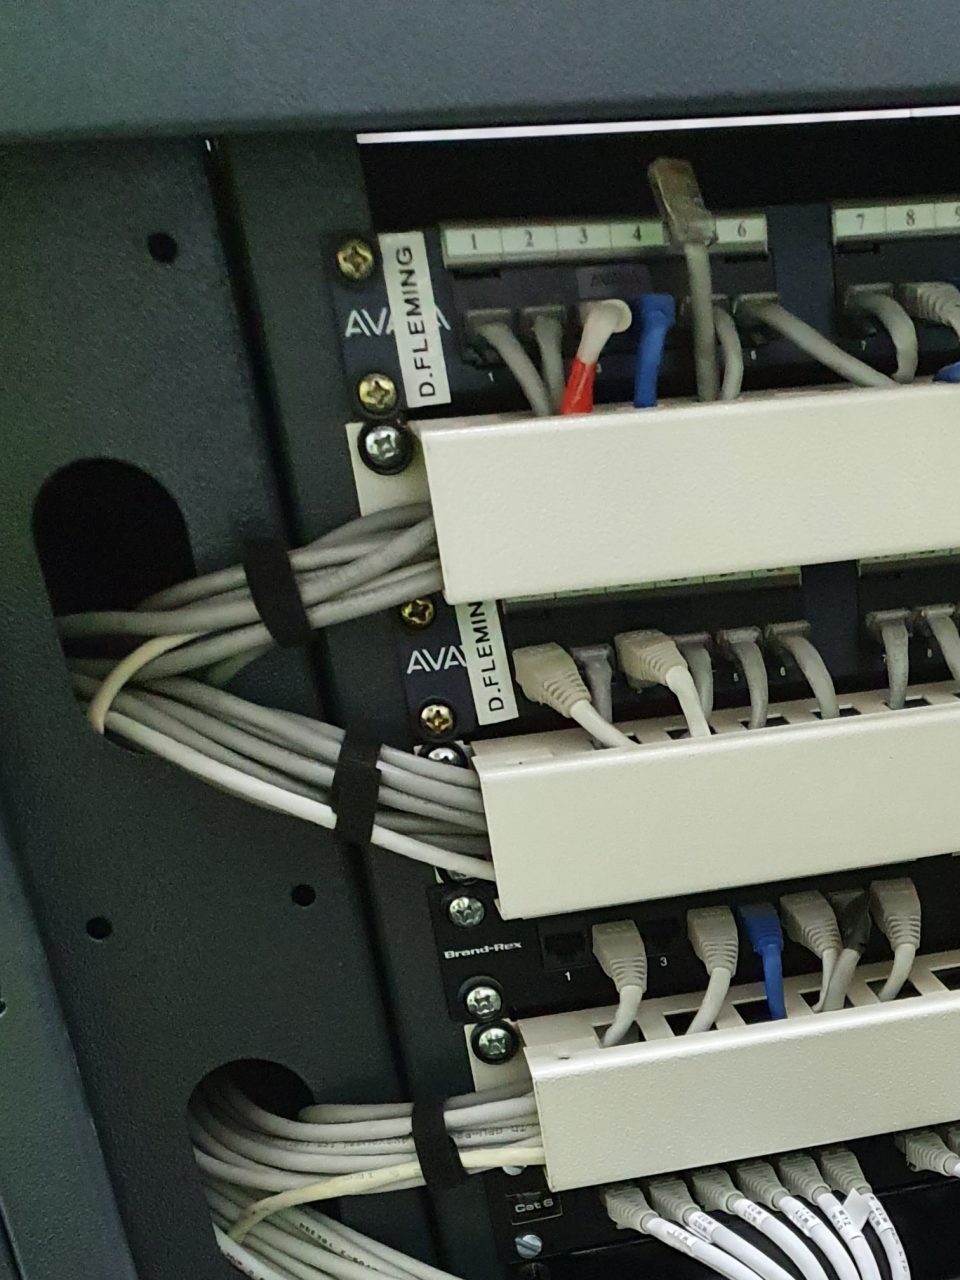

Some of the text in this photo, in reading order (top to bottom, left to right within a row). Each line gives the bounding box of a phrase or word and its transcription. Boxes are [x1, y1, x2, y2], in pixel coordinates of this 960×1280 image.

[856, 214, 865, 230] 7
[905, 209, 916, 226] 8
[471, 221, 748, 250] 1 2 3 4 6
[344, 306, 452, 338] AVA
[395, 246, 436, 398] D.FLEMING
[406, 645, 467, 675] AVA
[469, 601, 505, 712] D.FLEMIN
[443, 941, 523, 959] Brand-Rex
[563, 970, 571, 982] 1
[659, 955, 669, 967] 3
